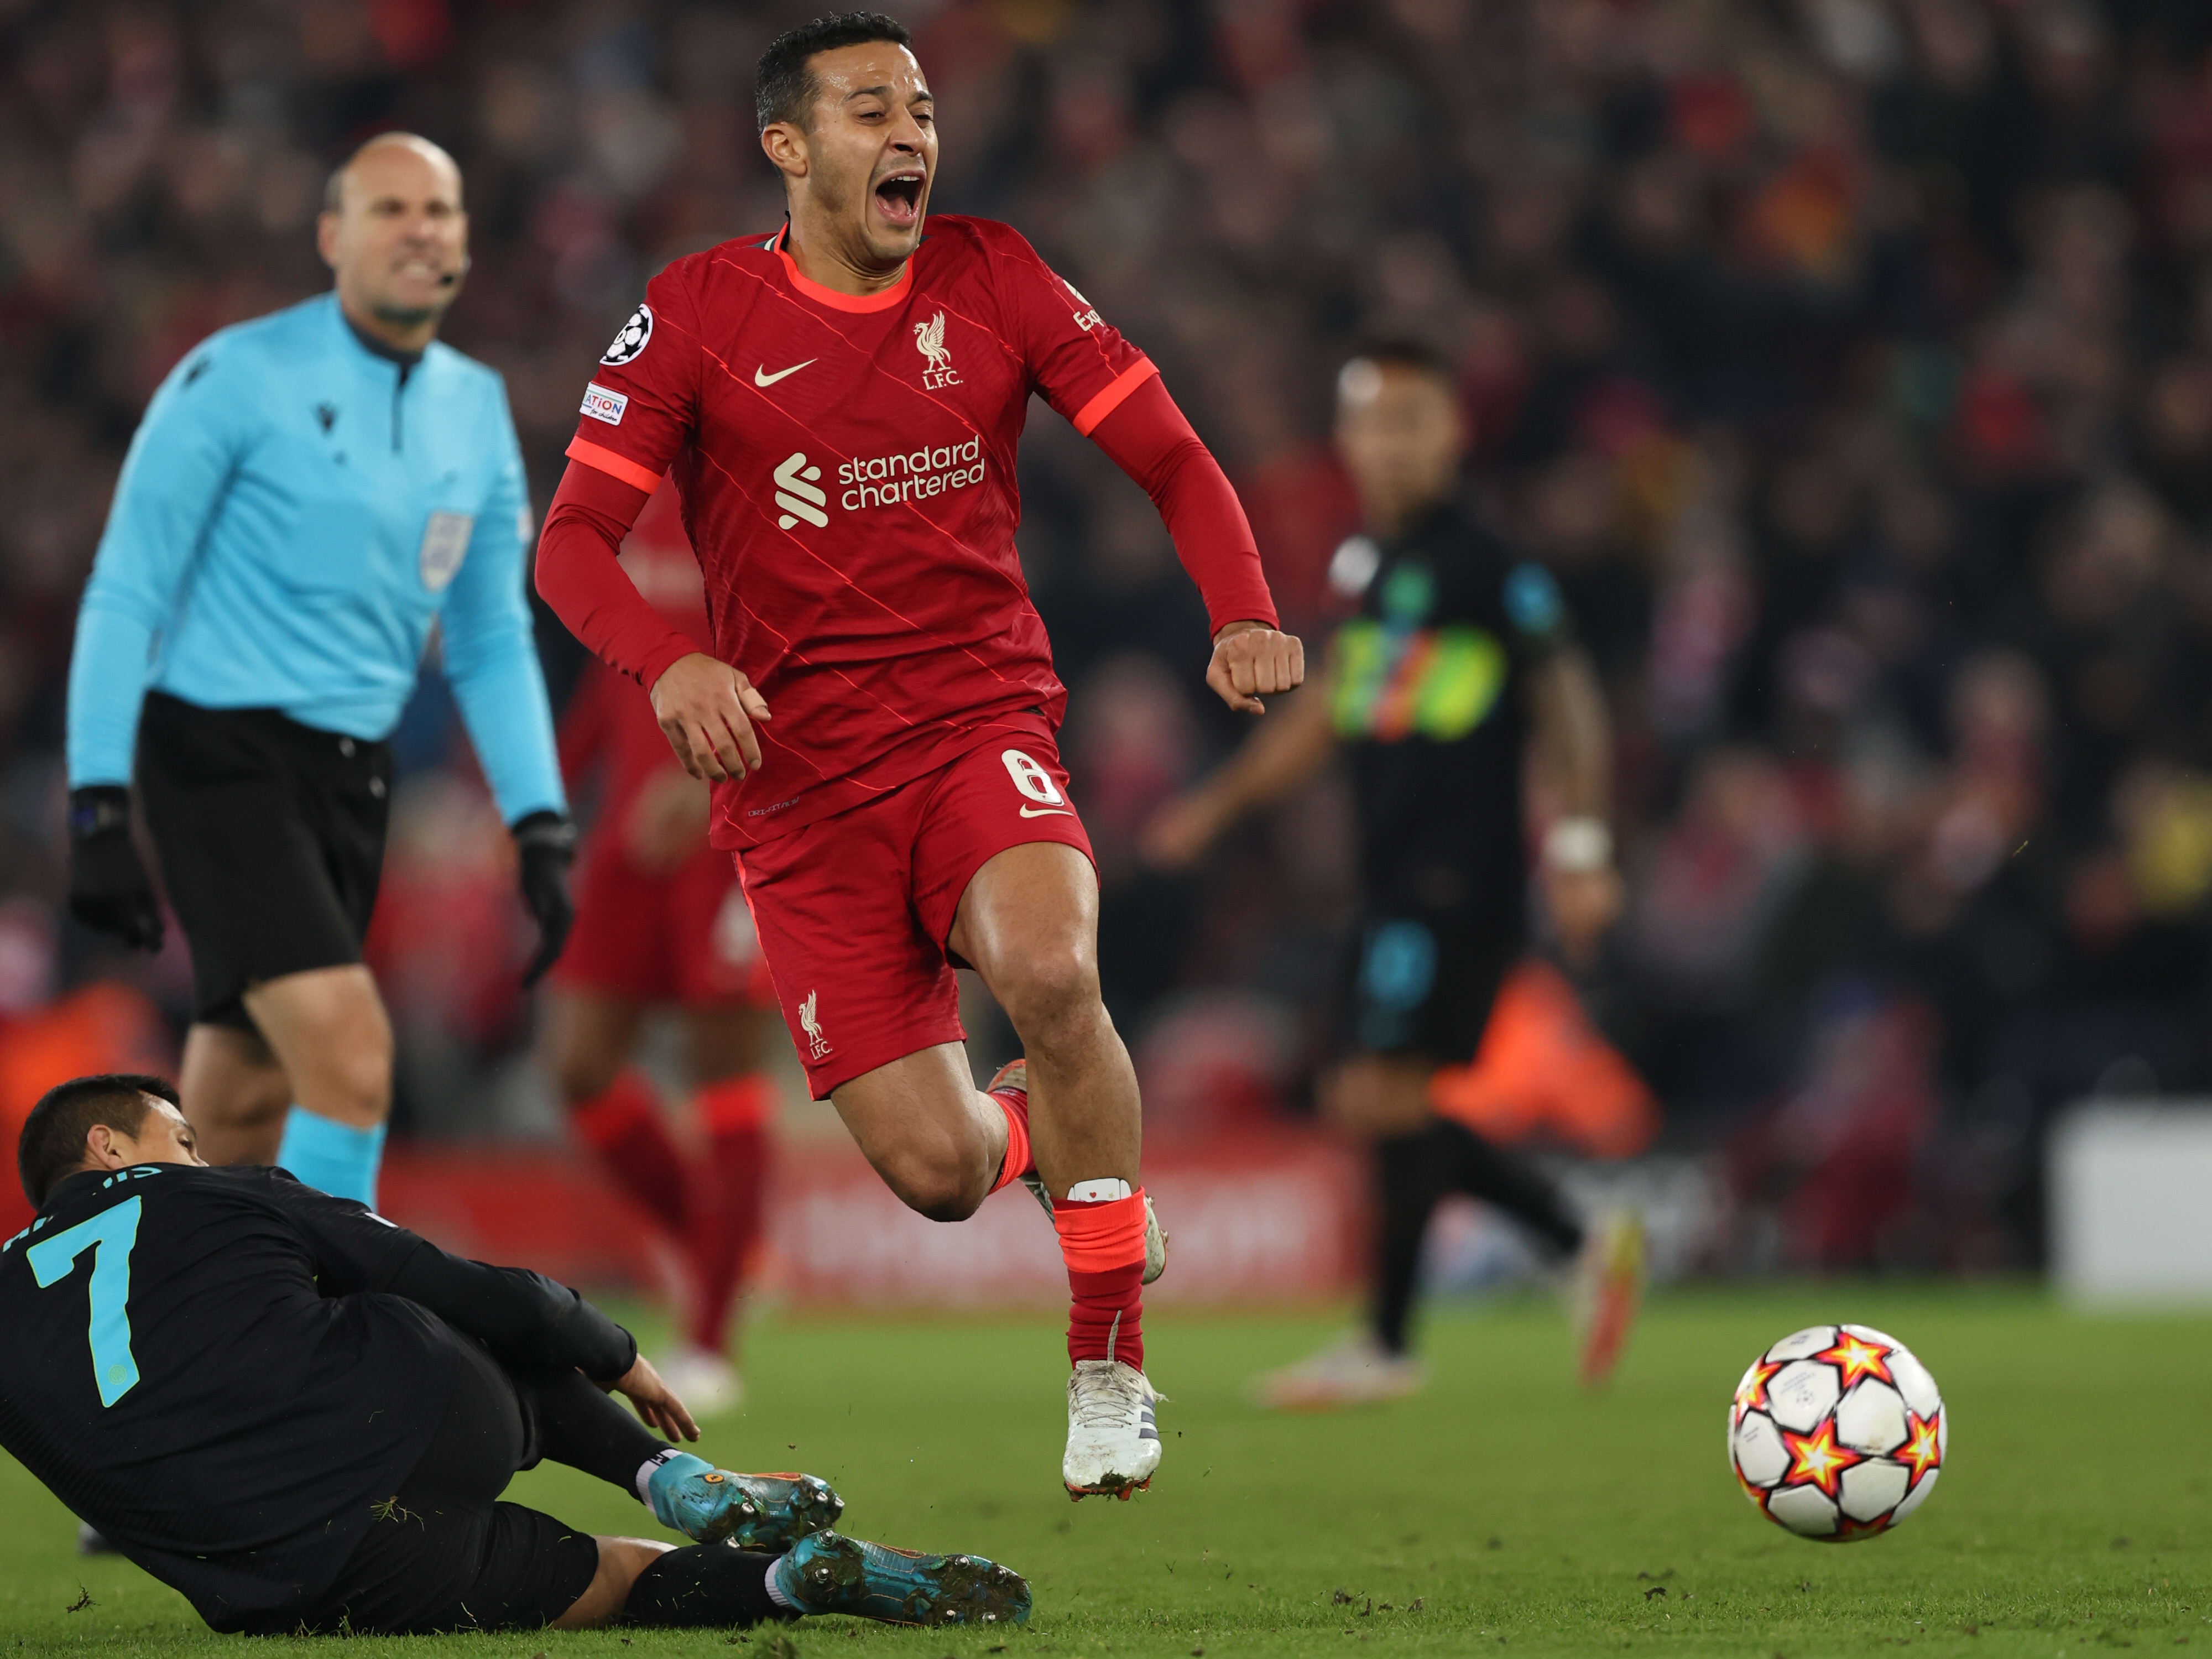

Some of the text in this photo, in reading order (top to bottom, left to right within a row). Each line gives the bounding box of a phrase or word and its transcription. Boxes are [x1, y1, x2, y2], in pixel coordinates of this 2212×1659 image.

[838, 434, 979, 484] standard
[842, 458, 985, 510] chartered
[27, 1195, 142, 1408] 7
